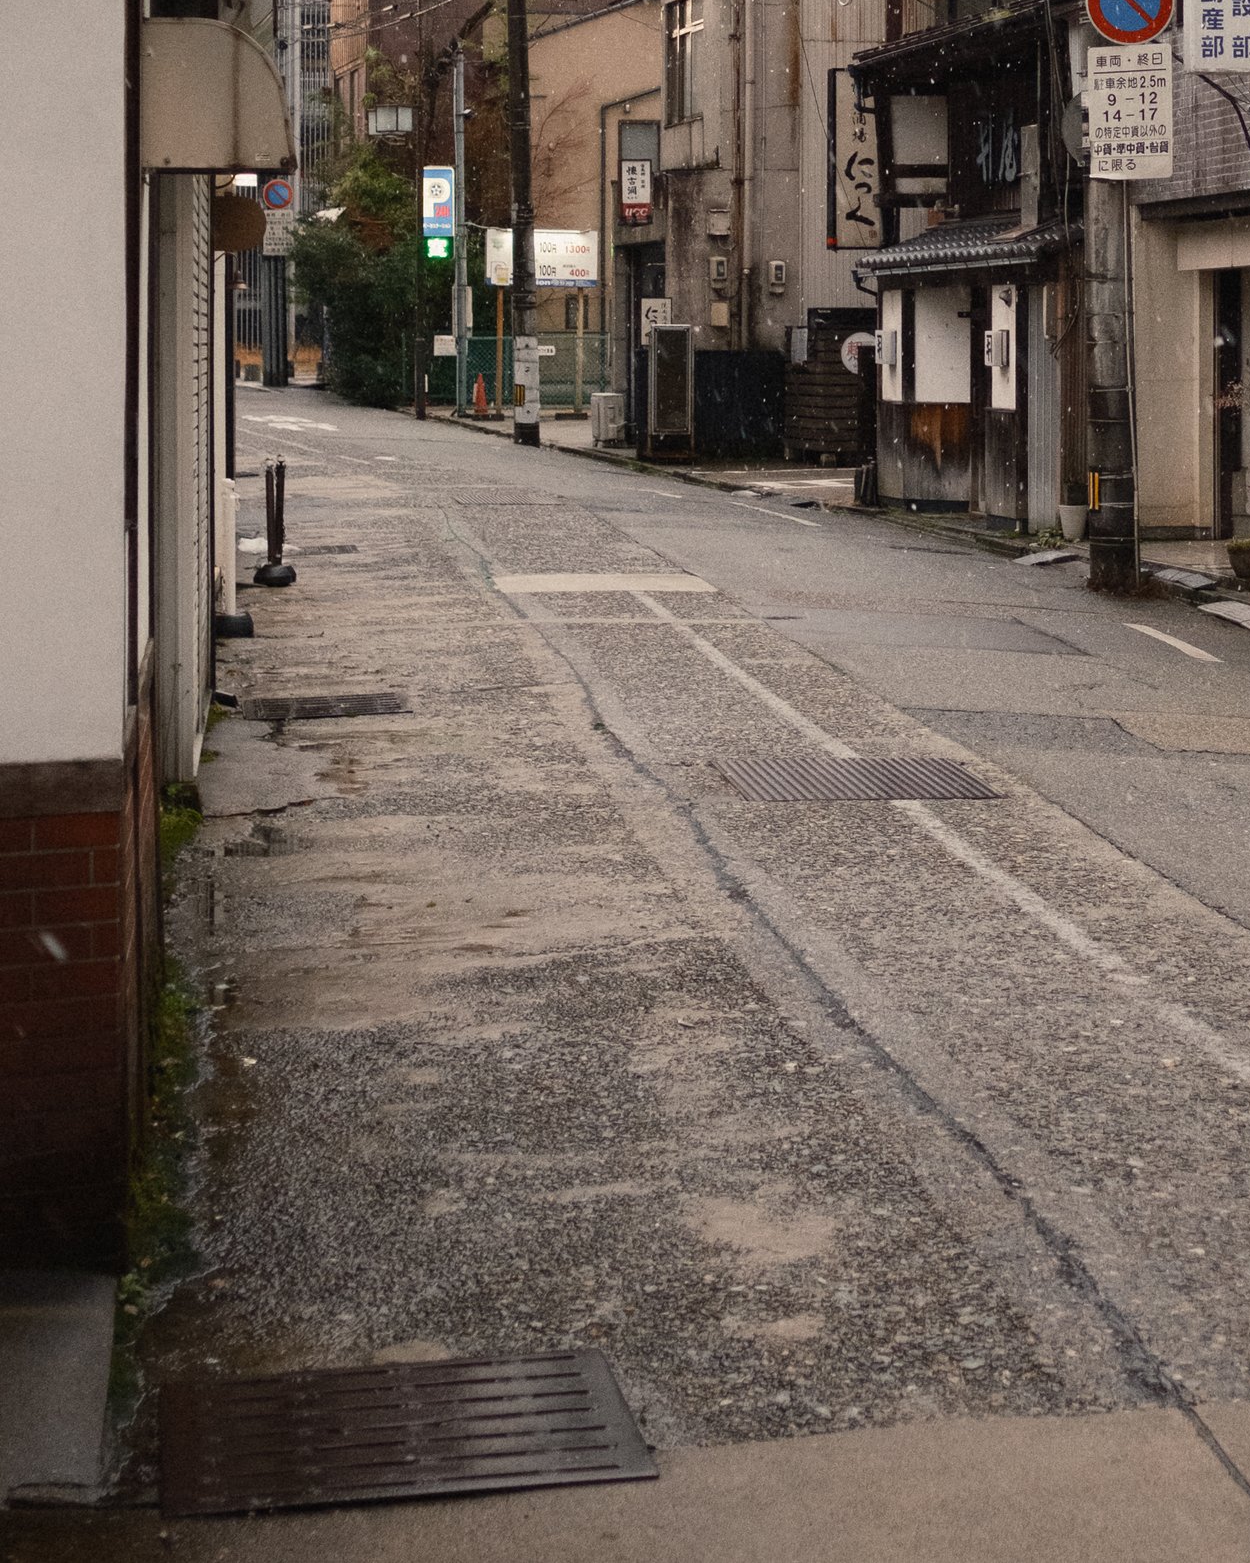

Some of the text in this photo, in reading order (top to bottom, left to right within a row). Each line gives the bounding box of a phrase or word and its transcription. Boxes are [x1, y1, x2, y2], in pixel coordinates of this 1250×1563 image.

[1096, 52, 1163, 69] 車両・終日
[1095, 124, 1166, 139] の特定中貨以外の
[1098, 159, 1137, 172] に限る
[423, 177, 451, 217] P
